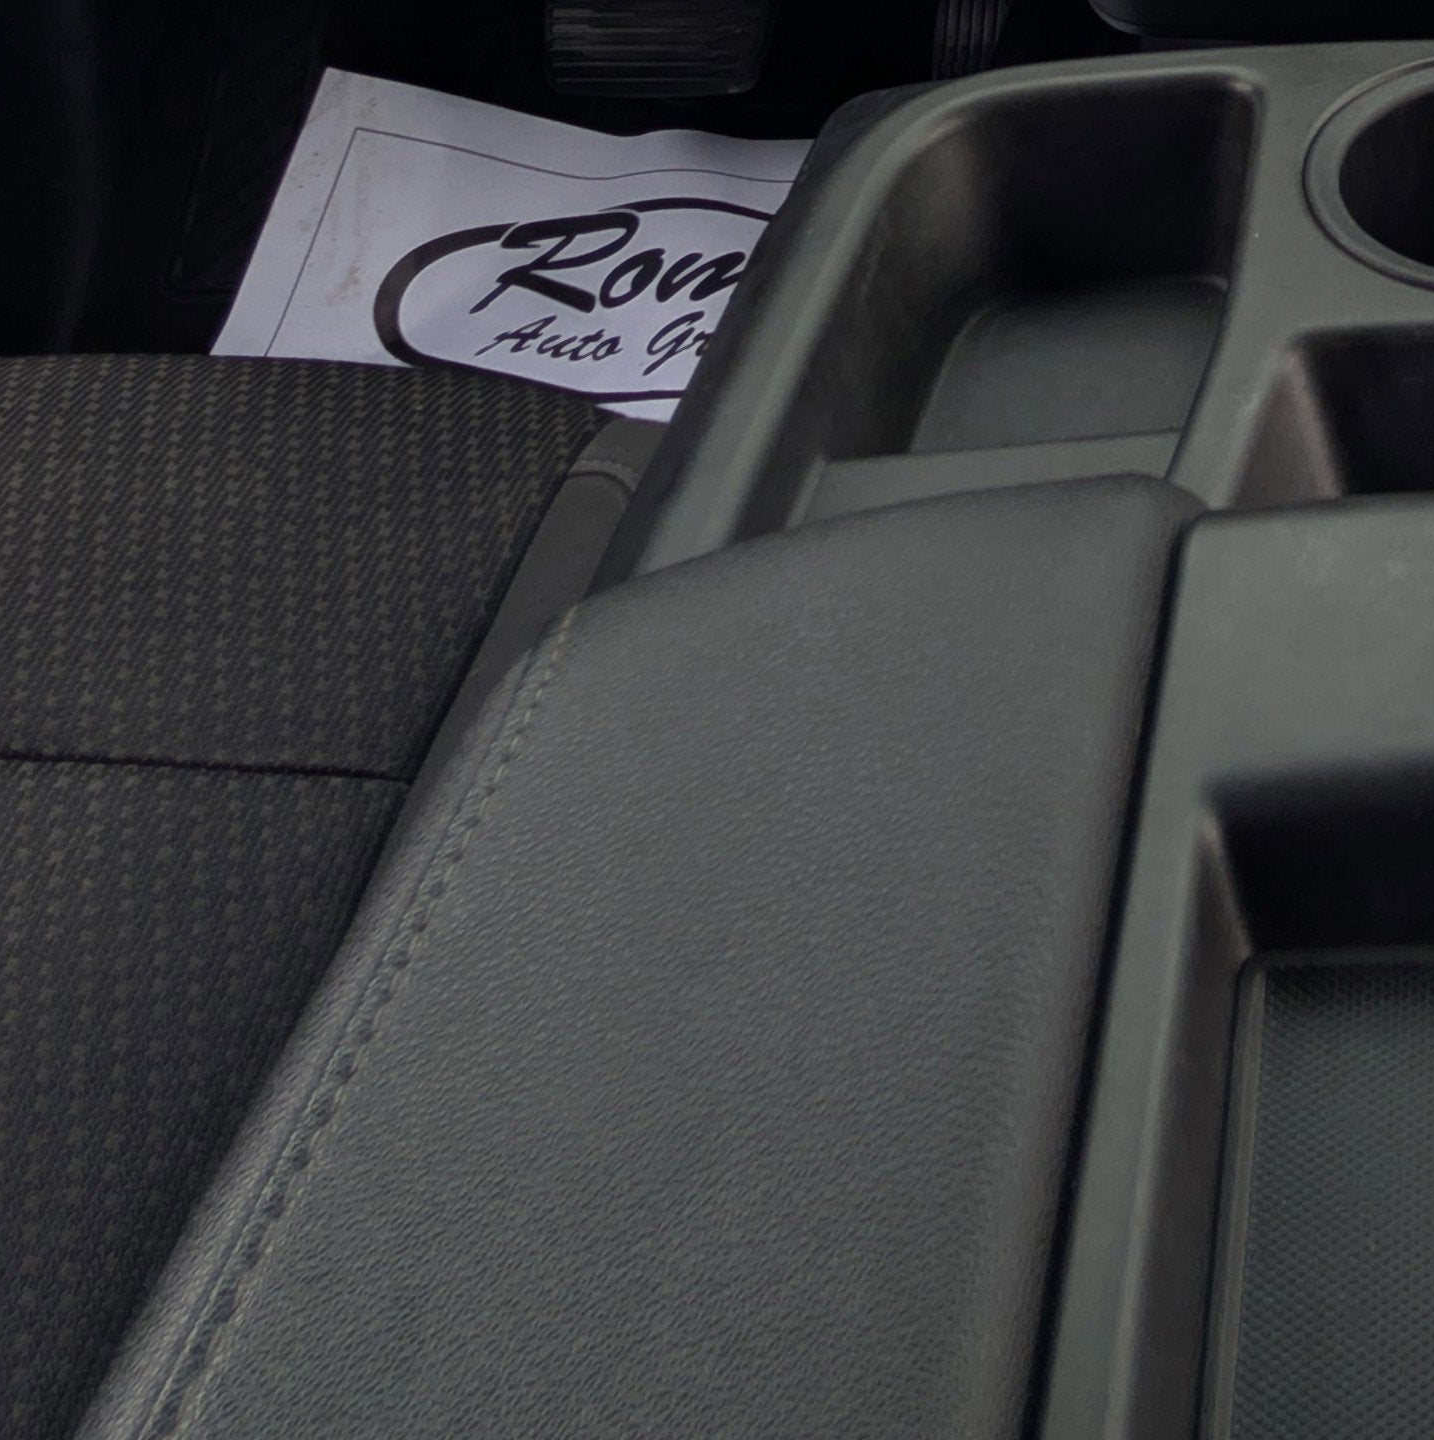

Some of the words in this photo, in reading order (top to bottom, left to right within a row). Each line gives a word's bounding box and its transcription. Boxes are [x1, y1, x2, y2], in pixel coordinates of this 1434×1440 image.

[469, 211, 747, 314] Rom
[474, 315, 623, 362] Auto
[642, 310, 716, 377] Gr
